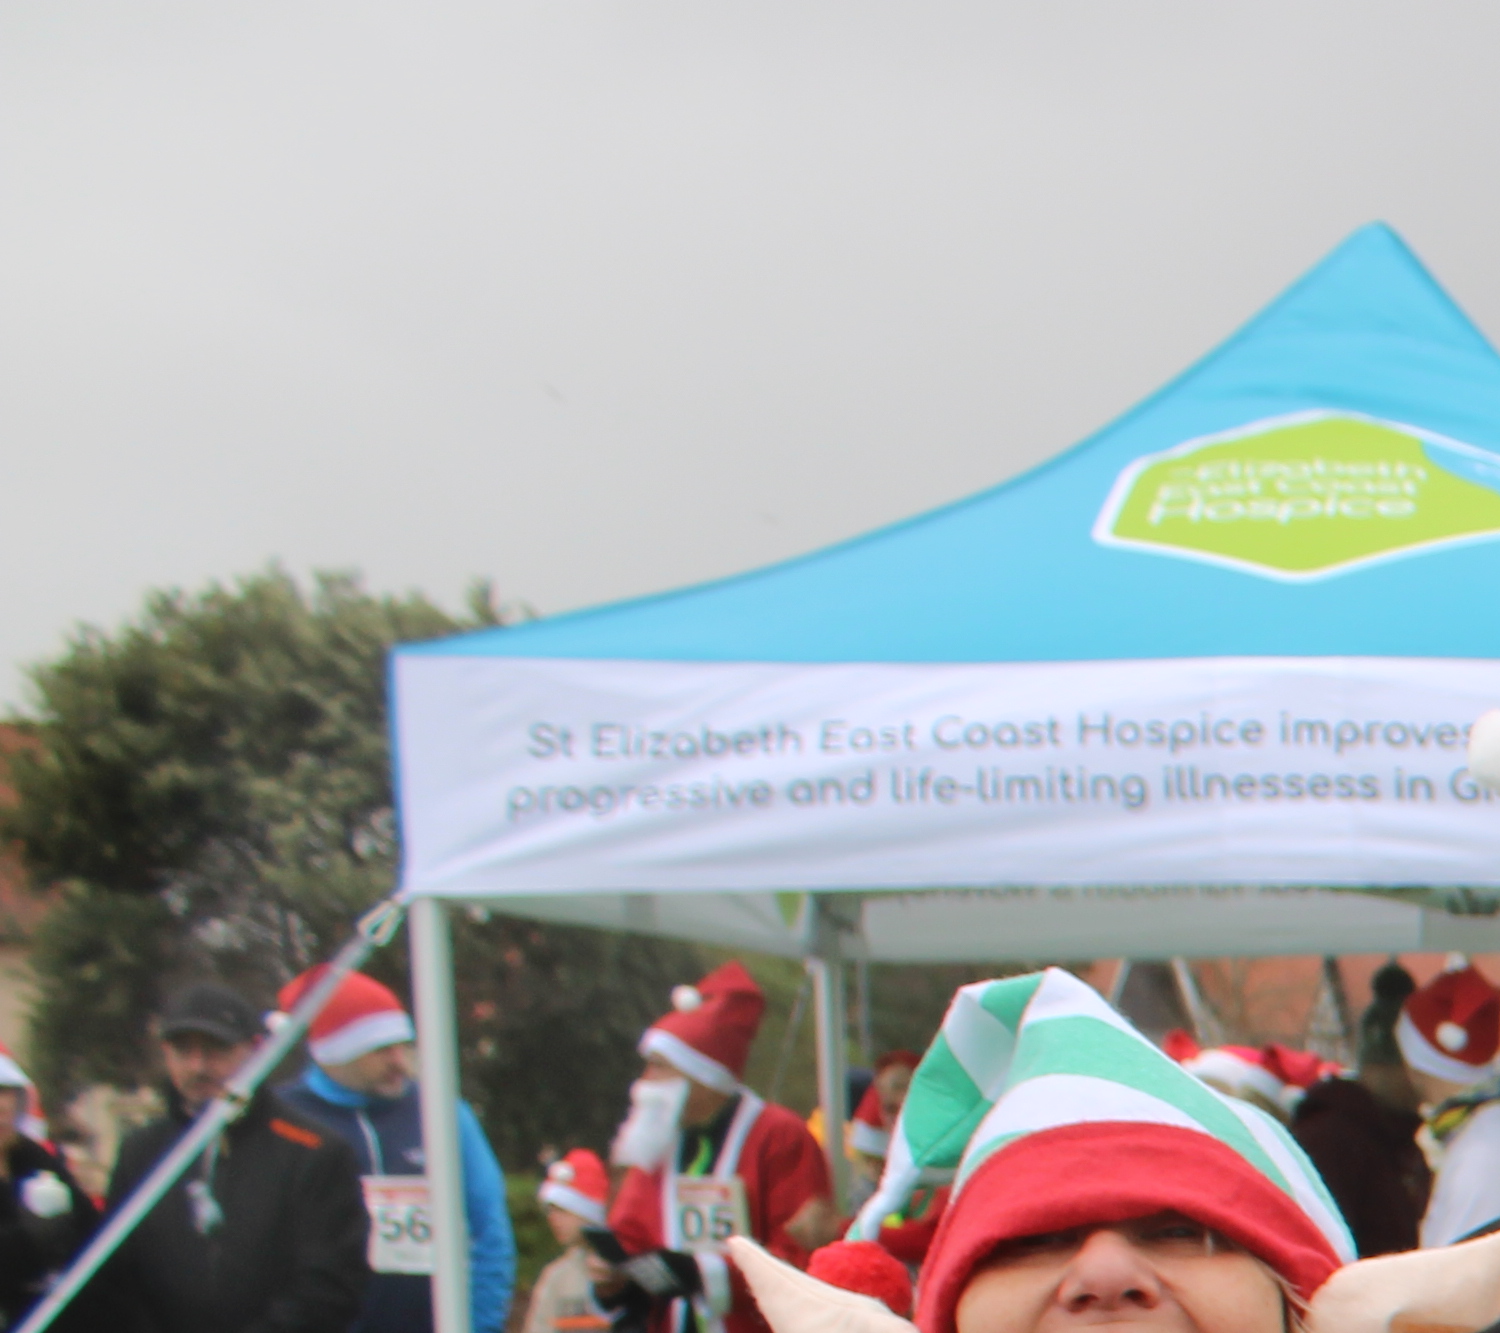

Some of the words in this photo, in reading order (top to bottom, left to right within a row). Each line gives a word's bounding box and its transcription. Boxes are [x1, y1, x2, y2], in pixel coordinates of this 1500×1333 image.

[1147, 495, 1417, 526] Hospice
[528, 722, 574, 759] St
[592, 721, 804, 759] Elizabeth
[820, 718, 916, 753] East
[931, 713, 1062, 750] Coast
[1077, 713, 1264, 754] Hospice
[1279, 713, 1474, 758] improves
[508, 775, 774, 822] progressive
[786, 769, 876, 809] and
[890, 766, 1149, 810] life-limiting
[1162, 766, 1380, 804] illnessess
[1394, 767, 1434, 801] in
